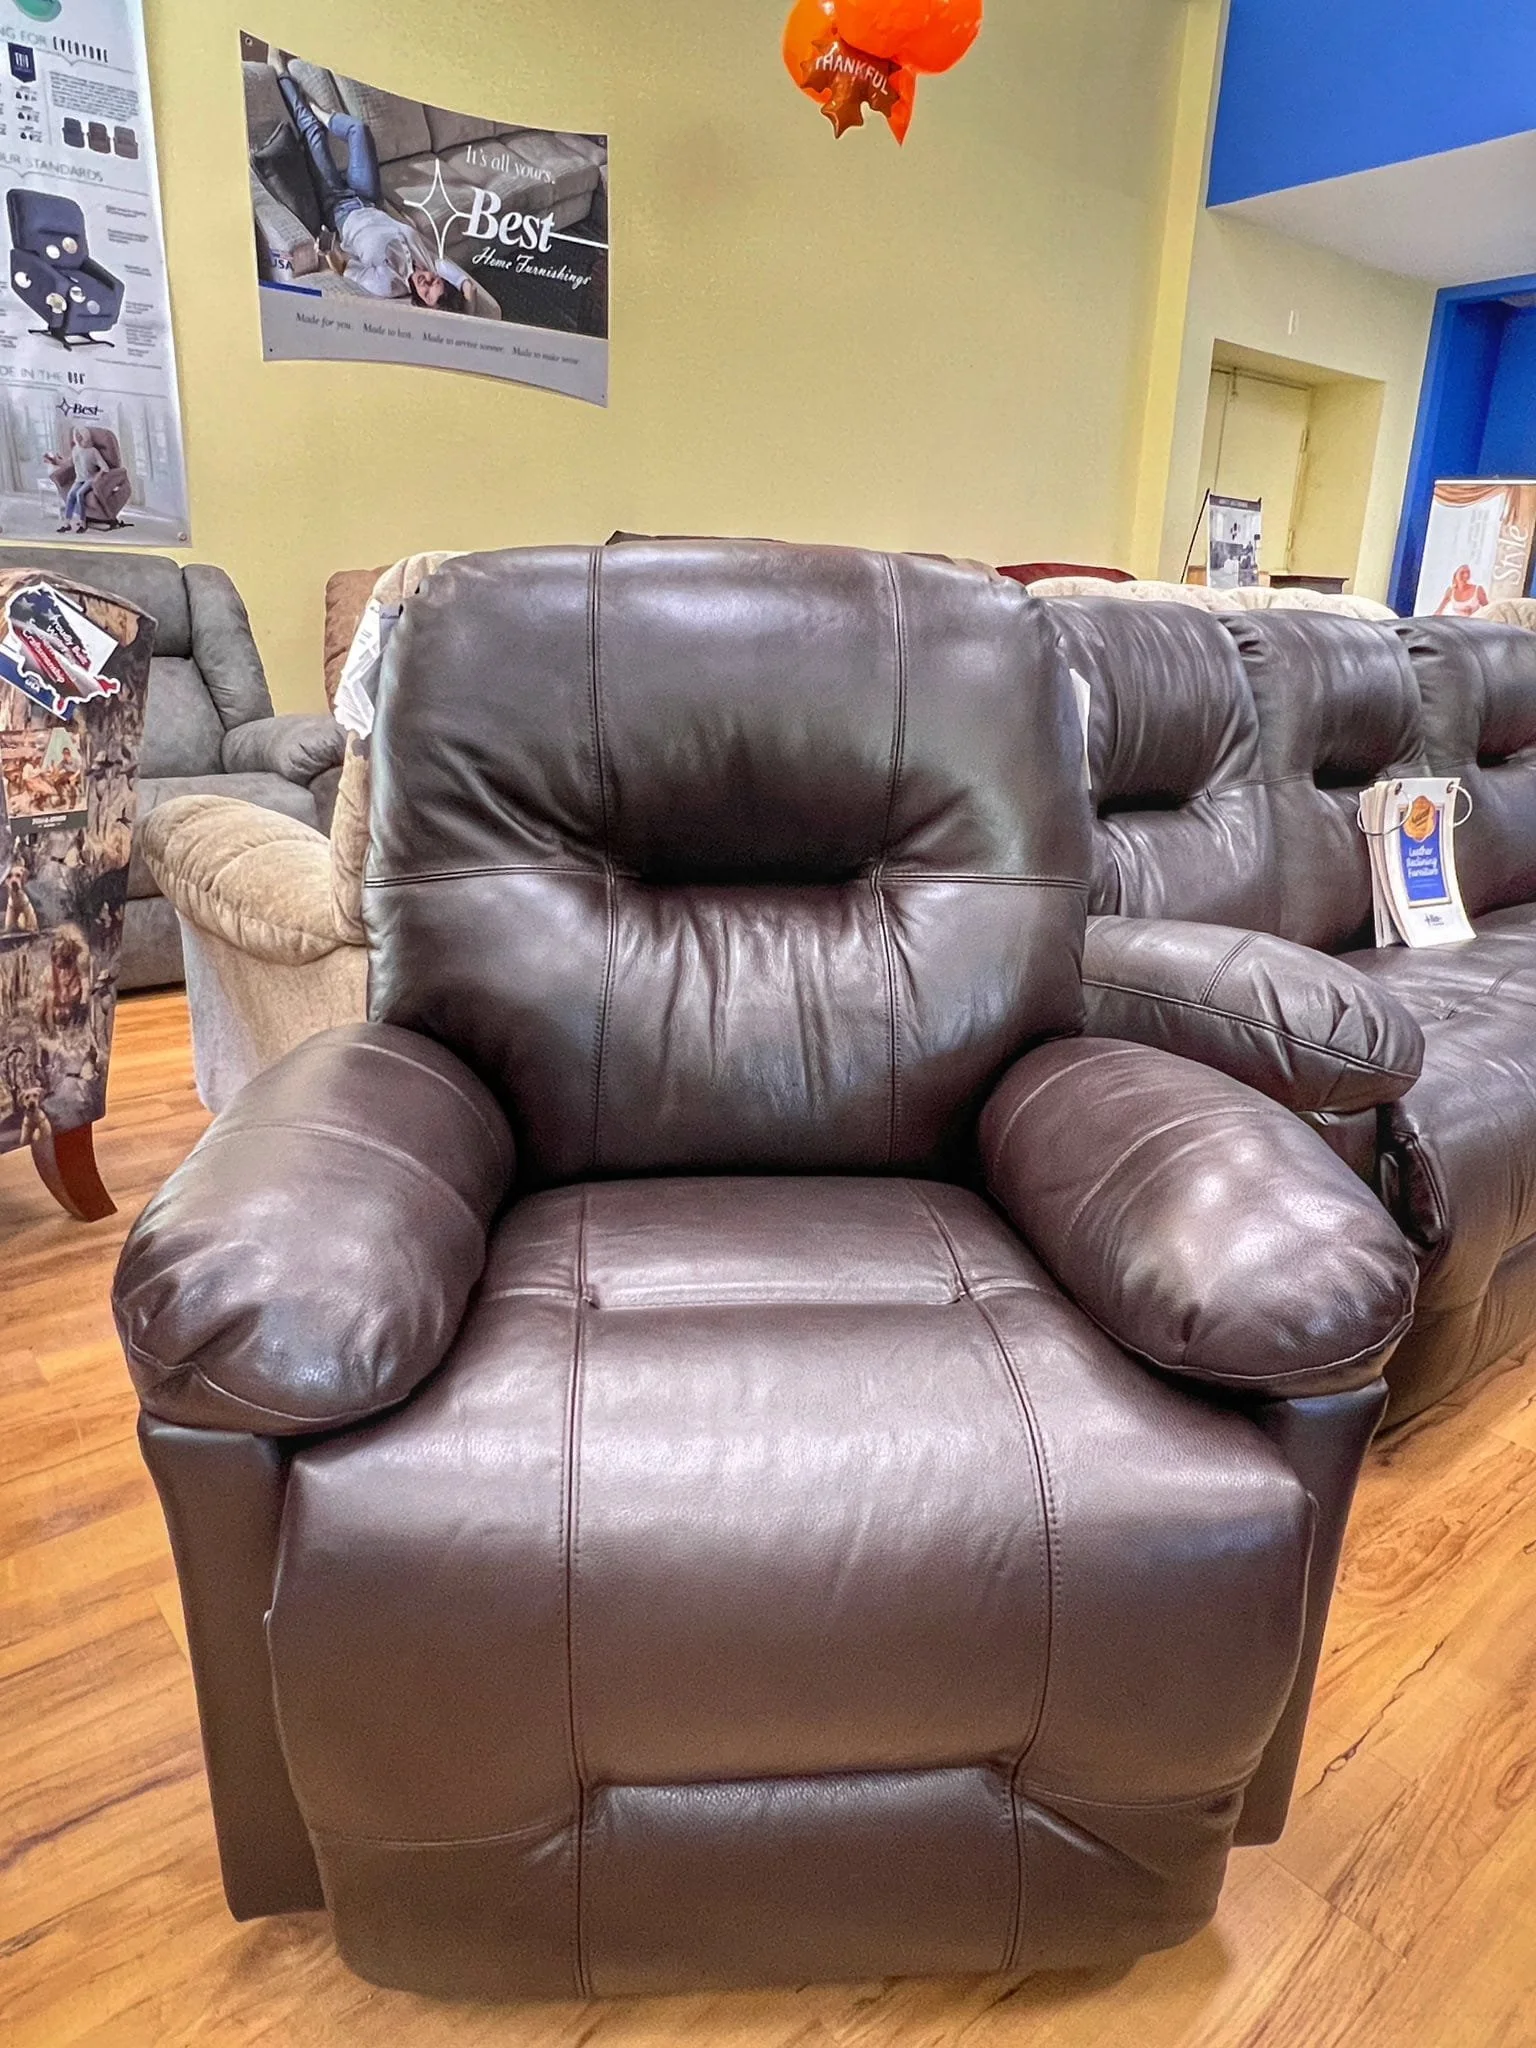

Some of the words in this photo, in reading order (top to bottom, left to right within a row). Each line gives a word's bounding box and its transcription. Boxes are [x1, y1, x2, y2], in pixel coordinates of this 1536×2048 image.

[25, 158, 103, 181] STANDARDS
[466, 145, 487, 167] It's
[491, 153, 510, 173] all
[514, 162, 556, 185] yours.
[462, 186, 556, 253] Best
[472, 246, 513, 270] Home
[515, 254, 592, 290] Furnishings
[296, 312, 320, 325] Made
[320, 316, 335, 329] for
[363, 323, 386, 336] Made
[422, 332, 444, 345] Made
[73, 403, 99, 416] Best
[1493, 524, 1529, 586] Style
